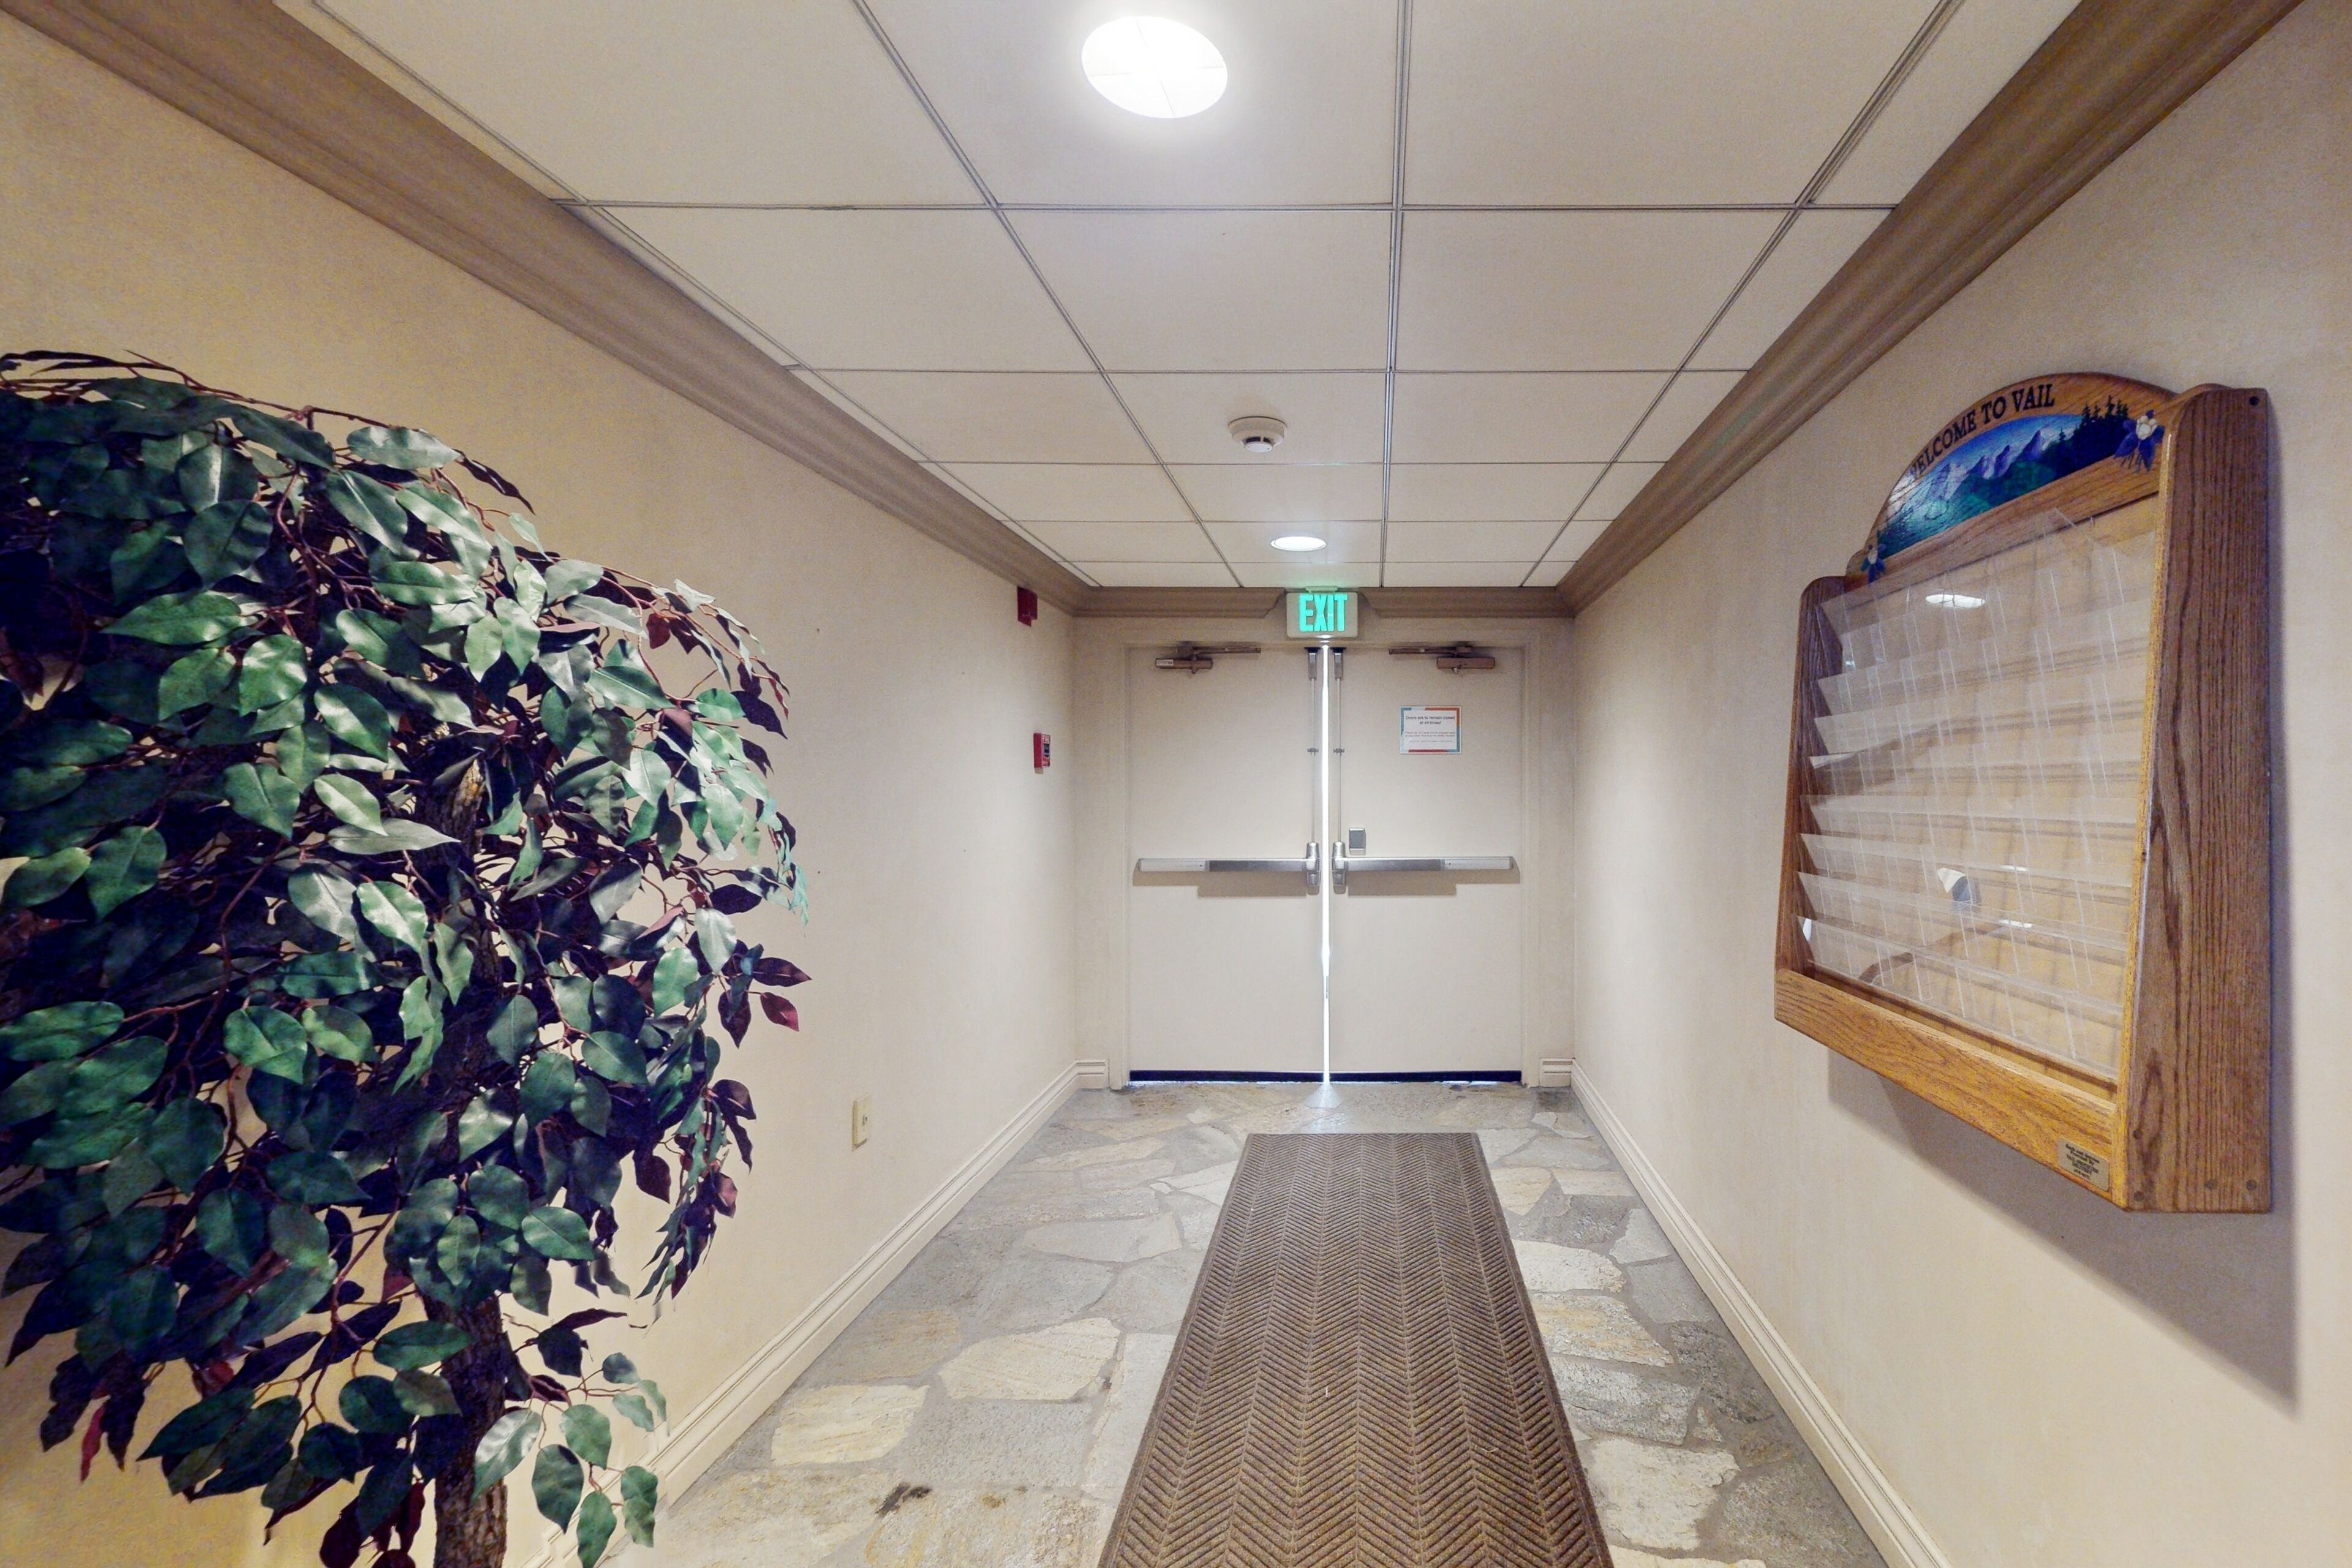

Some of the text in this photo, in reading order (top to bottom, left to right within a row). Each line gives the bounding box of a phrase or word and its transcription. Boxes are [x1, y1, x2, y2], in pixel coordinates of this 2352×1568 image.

[1981, 397, 2007, 425] TO
[2011, 383, 2055, 413] VAIL
[1299, 593, 1348, 633] EXIT
